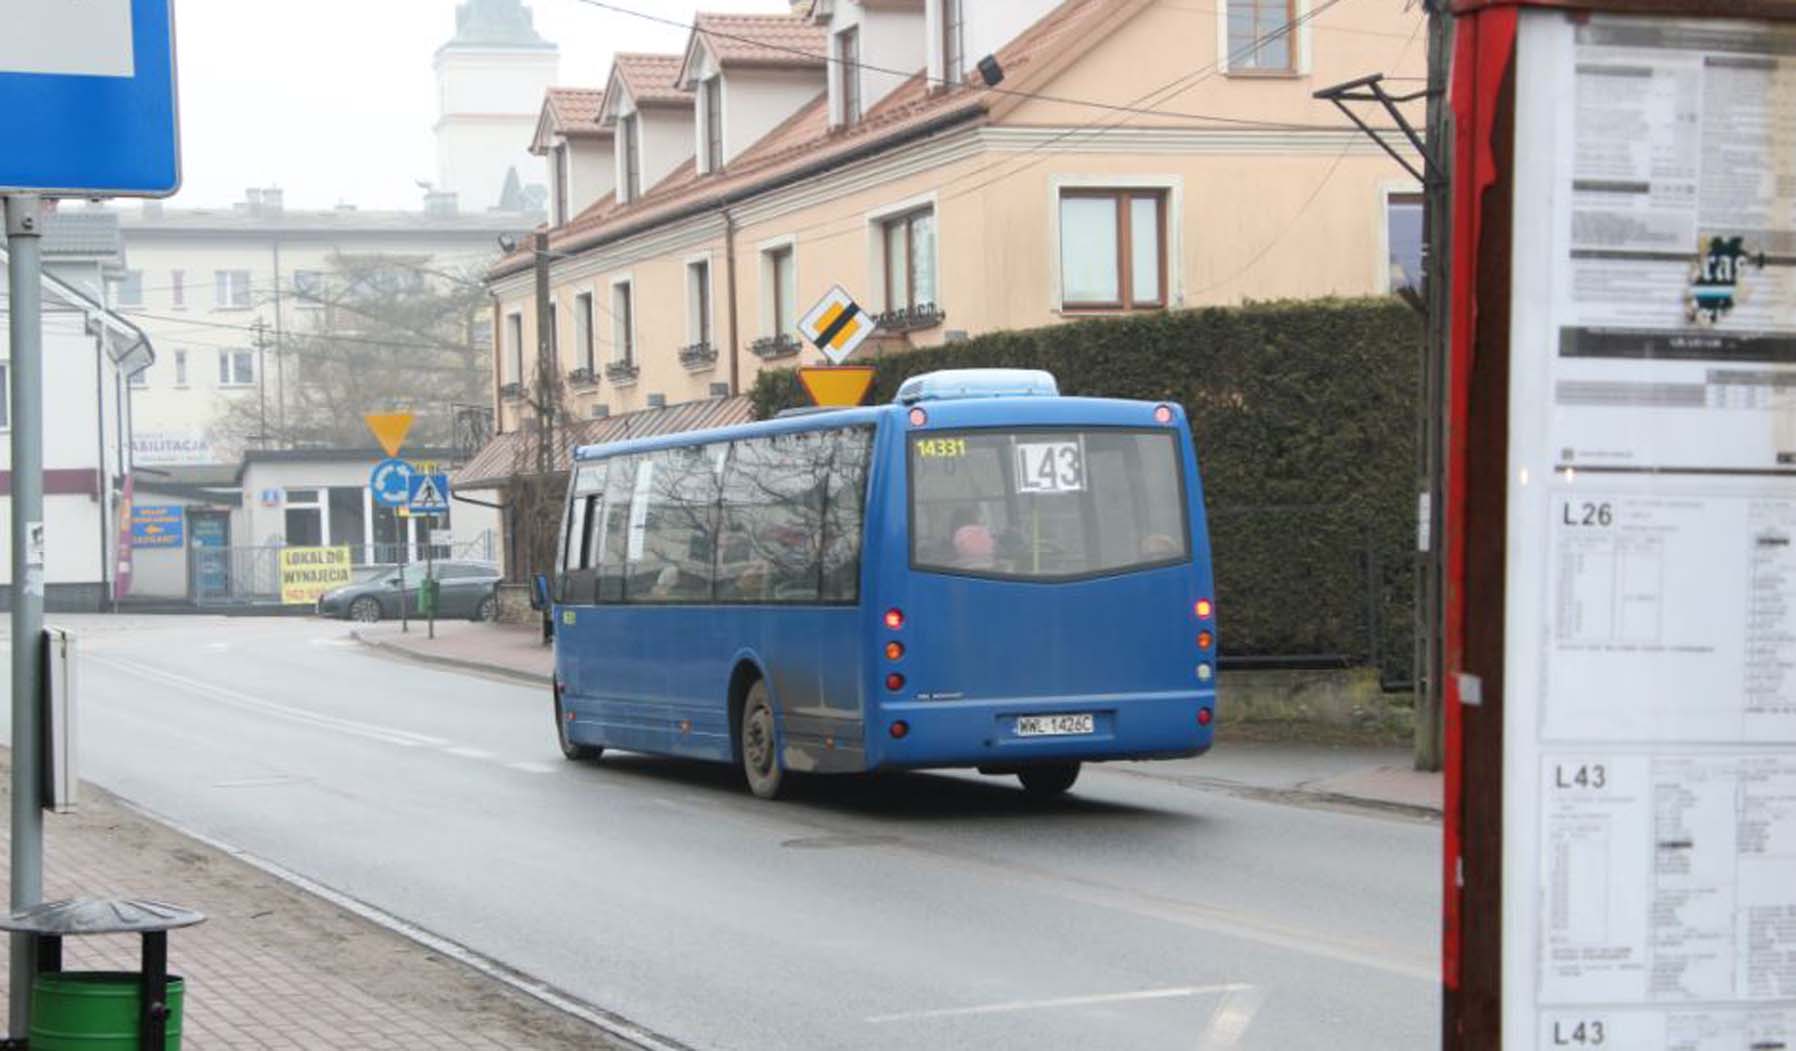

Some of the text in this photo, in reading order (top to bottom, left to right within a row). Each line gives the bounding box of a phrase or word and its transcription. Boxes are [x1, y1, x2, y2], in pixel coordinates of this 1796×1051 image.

[917, 439, 966, 457] 14331
[1020, 446, 1081, 489] L43
[1563, 502, 1612, 526] L26
[286, 551, 325, 565] LOKAL
[1050, 715, 1092, 732] 1426C
[1556, 765, 1605, 789] L43
[1554, 1021, 1605, 1046] L43
